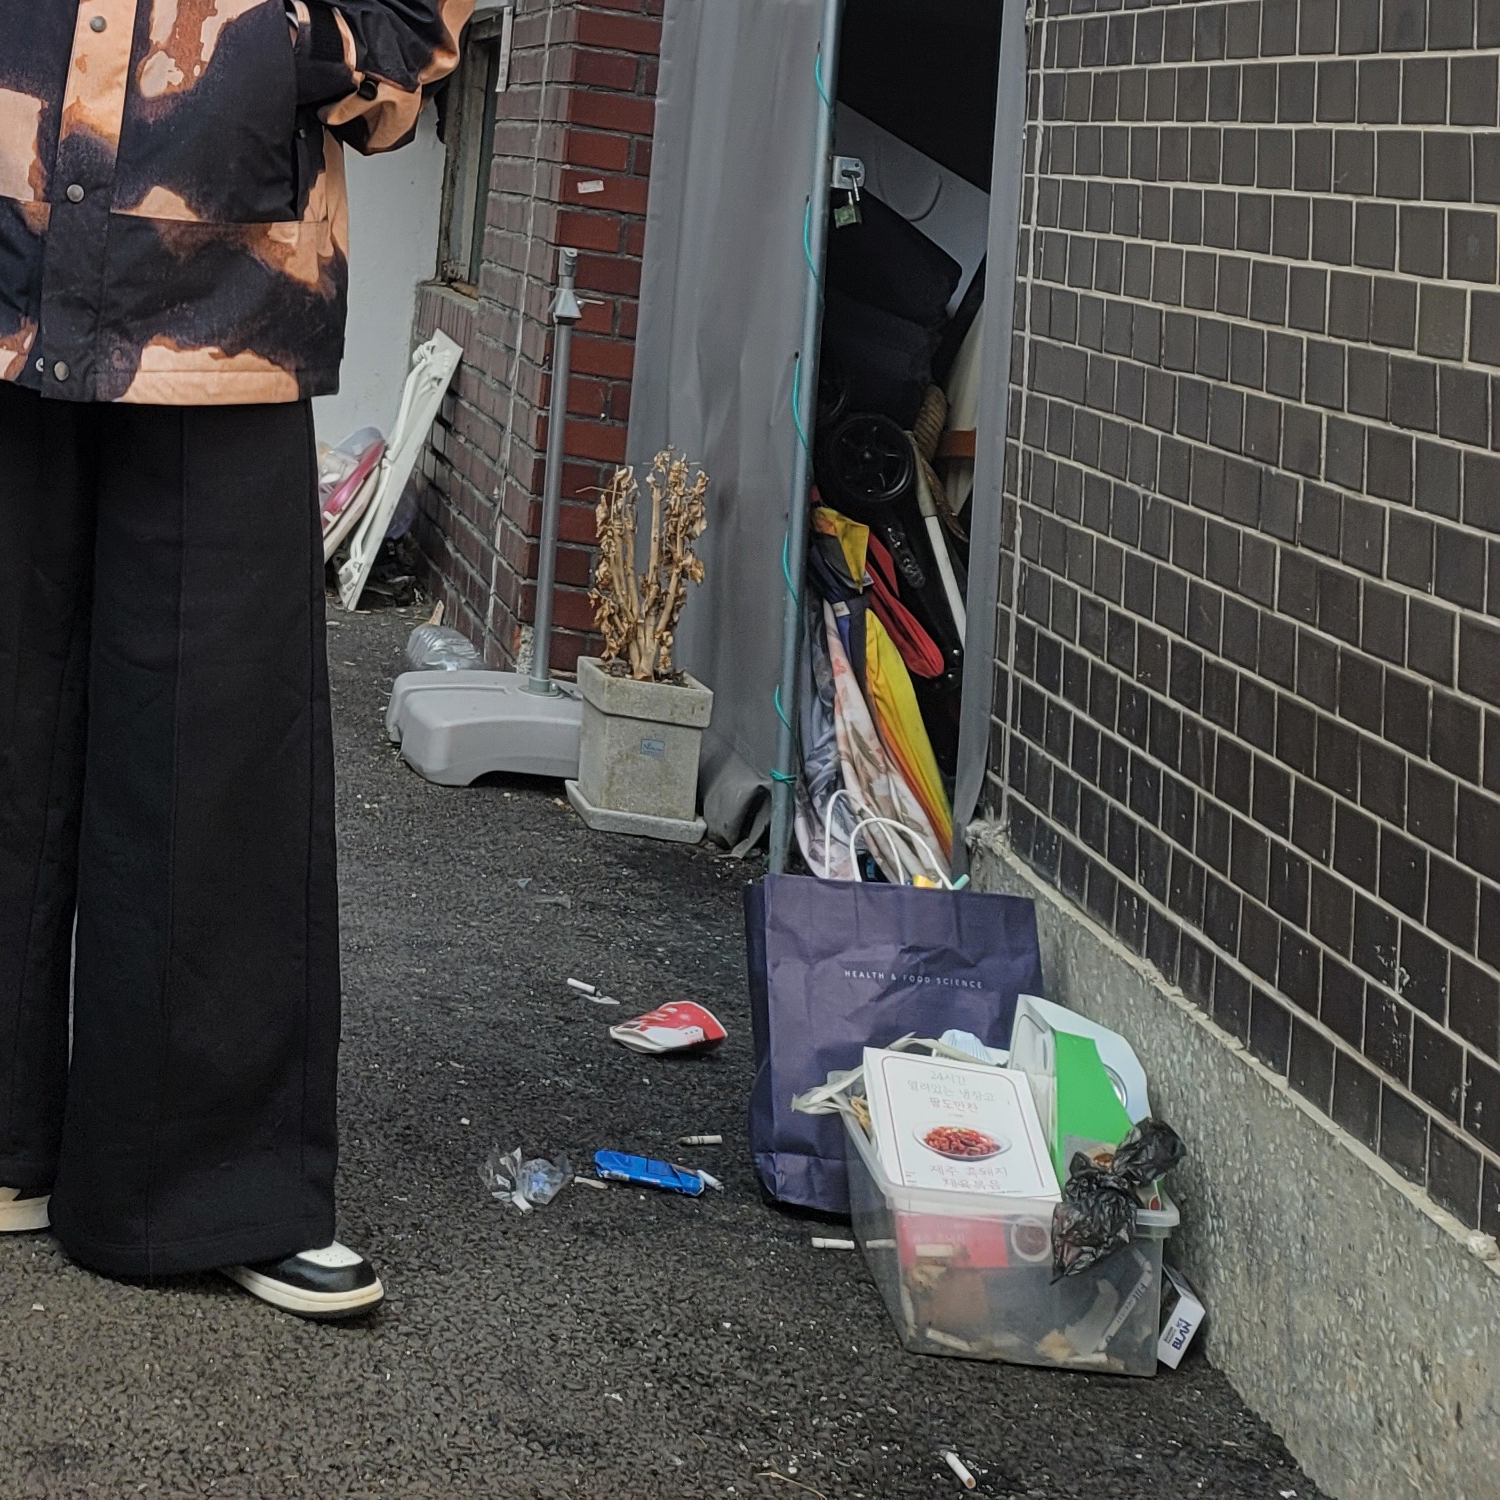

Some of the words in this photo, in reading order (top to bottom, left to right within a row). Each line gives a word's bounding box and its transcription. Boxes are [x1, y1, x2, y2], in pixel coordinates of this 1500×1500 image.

[844, 970, 885, 980] HEALTH
[890, 973, 897, 981] &
[936, 977, 983, 989] SCIENCE
